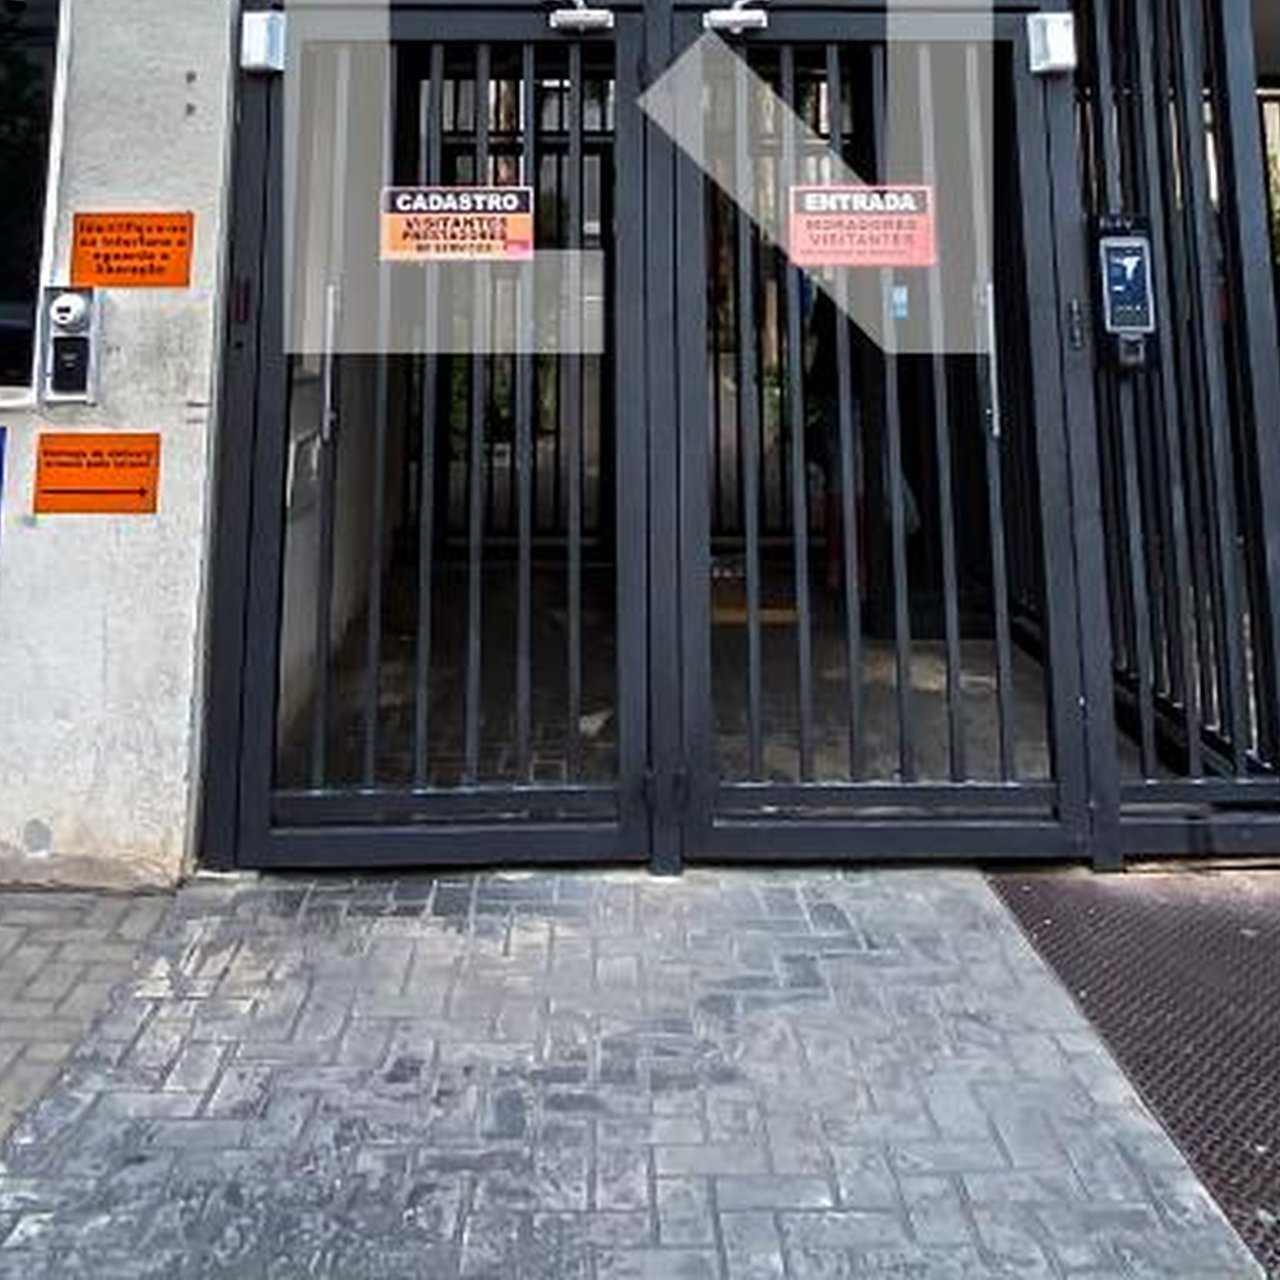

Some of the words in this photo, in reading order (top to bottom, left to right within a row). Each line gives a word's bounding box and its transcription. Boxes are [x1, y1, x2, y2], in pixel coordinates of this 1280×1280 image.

[396, 193, 519, 211] CADASTRO
[804, 192, 917, 211] ENTRADA
[810, 233, 915, 245] VISITANTES
